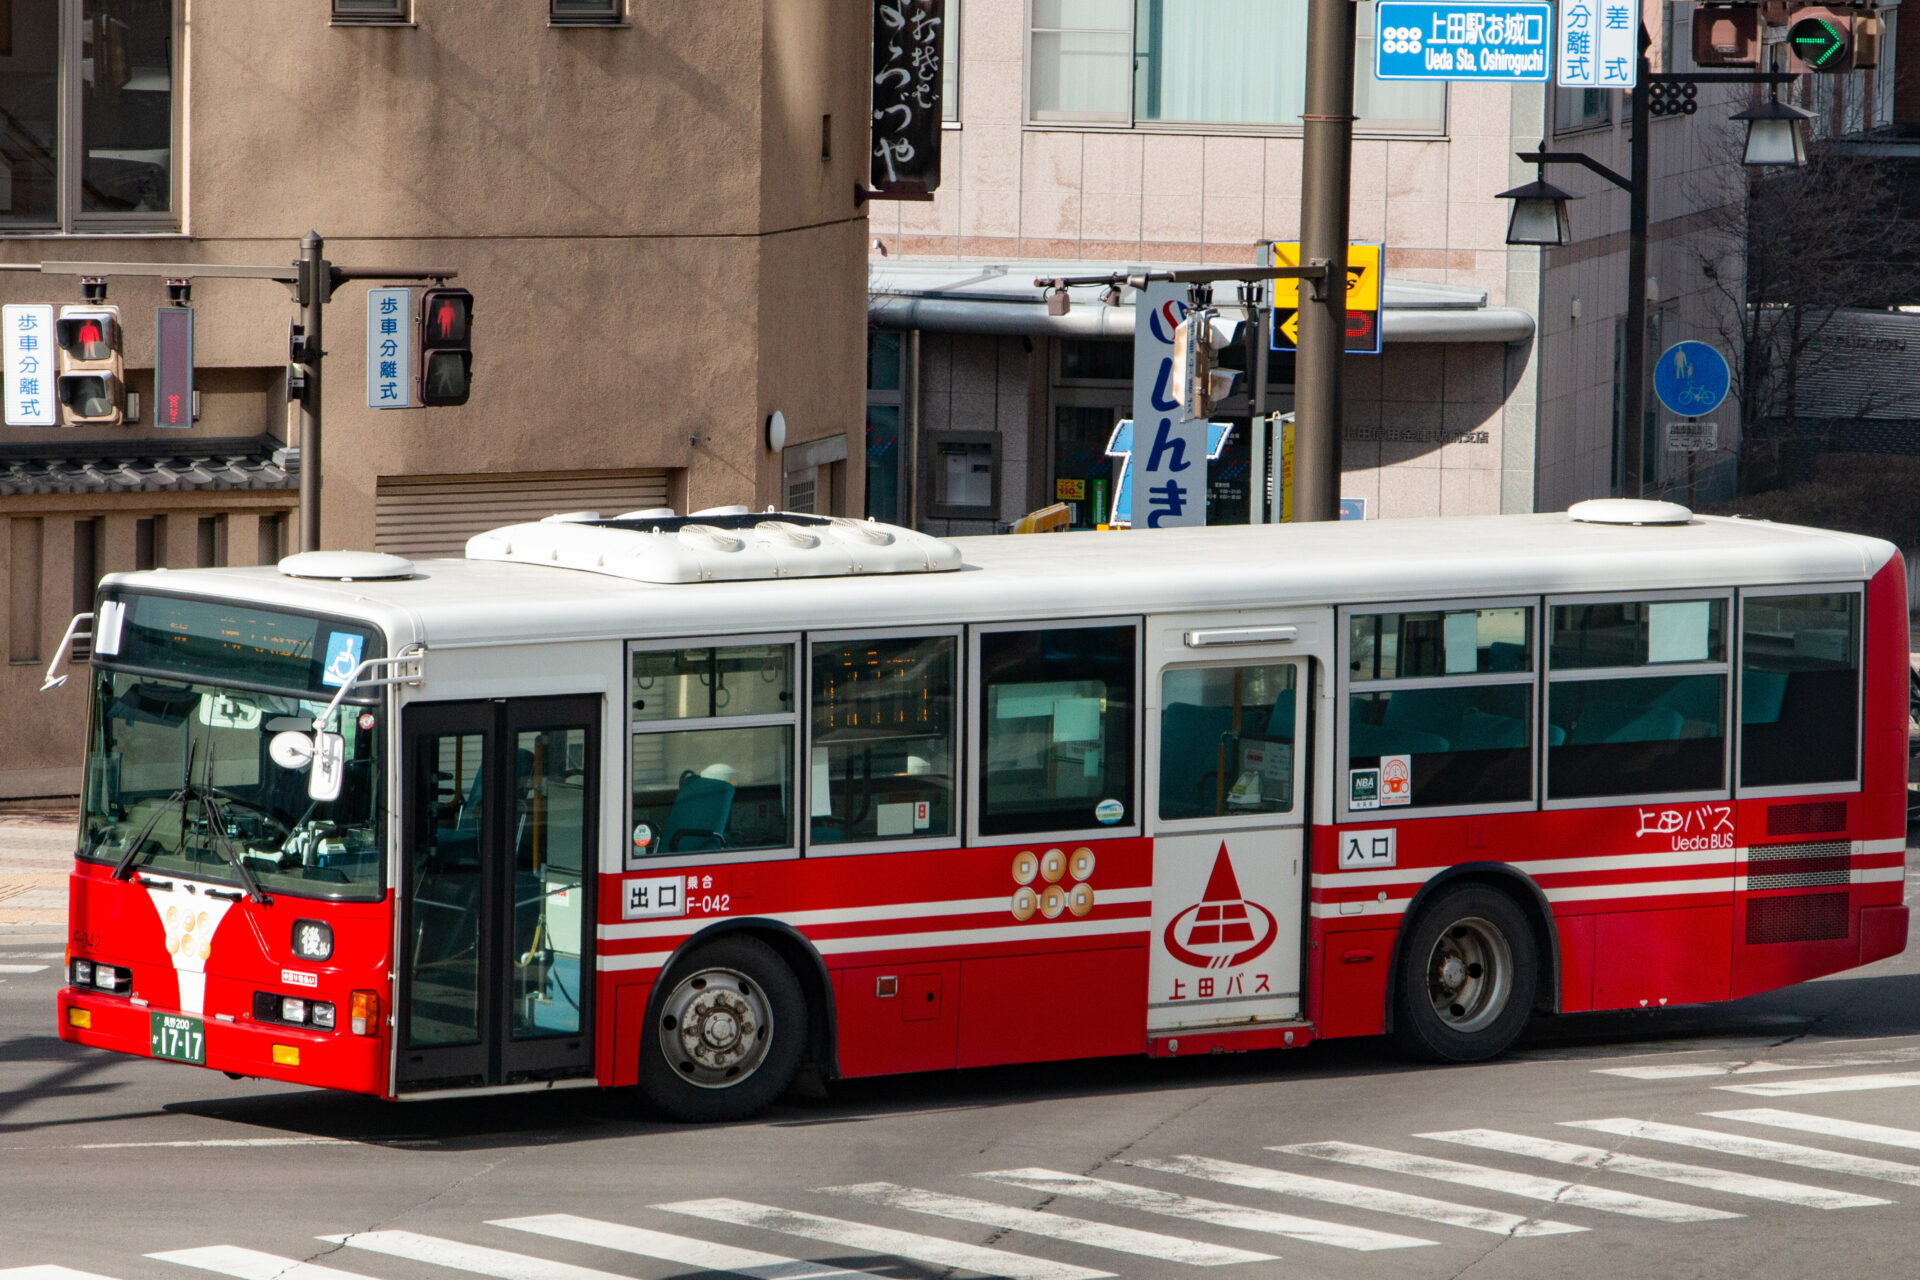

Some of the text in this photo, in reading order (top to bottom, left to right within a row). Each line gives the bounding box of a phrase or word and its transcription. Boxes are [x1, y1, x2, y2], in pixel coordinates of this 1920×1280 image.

[1426, 11, 1543, 46] 上田駅お城口
[1566, 0, 1592, 80] 分離式
[1425, 48, 1453, 71] Ueda
[1480, 48, 1544, 76] Oshiroguchi
[380, 297, 398, 400] 歩車分離式
[18, 313, 40, 417] 歩車分離式
[1355, 776, 1374, 789] NBA
[1346, 836, 1389, 860] 入口
[1671, 832, 1734, 851] Ueda BUS
[687, 875, 713, 890] 乗合
[630, 885, 677, 910] 出口
[686, 894, 730, 915] F-042
[1168, 972, 1270, 1001] 上田バス
